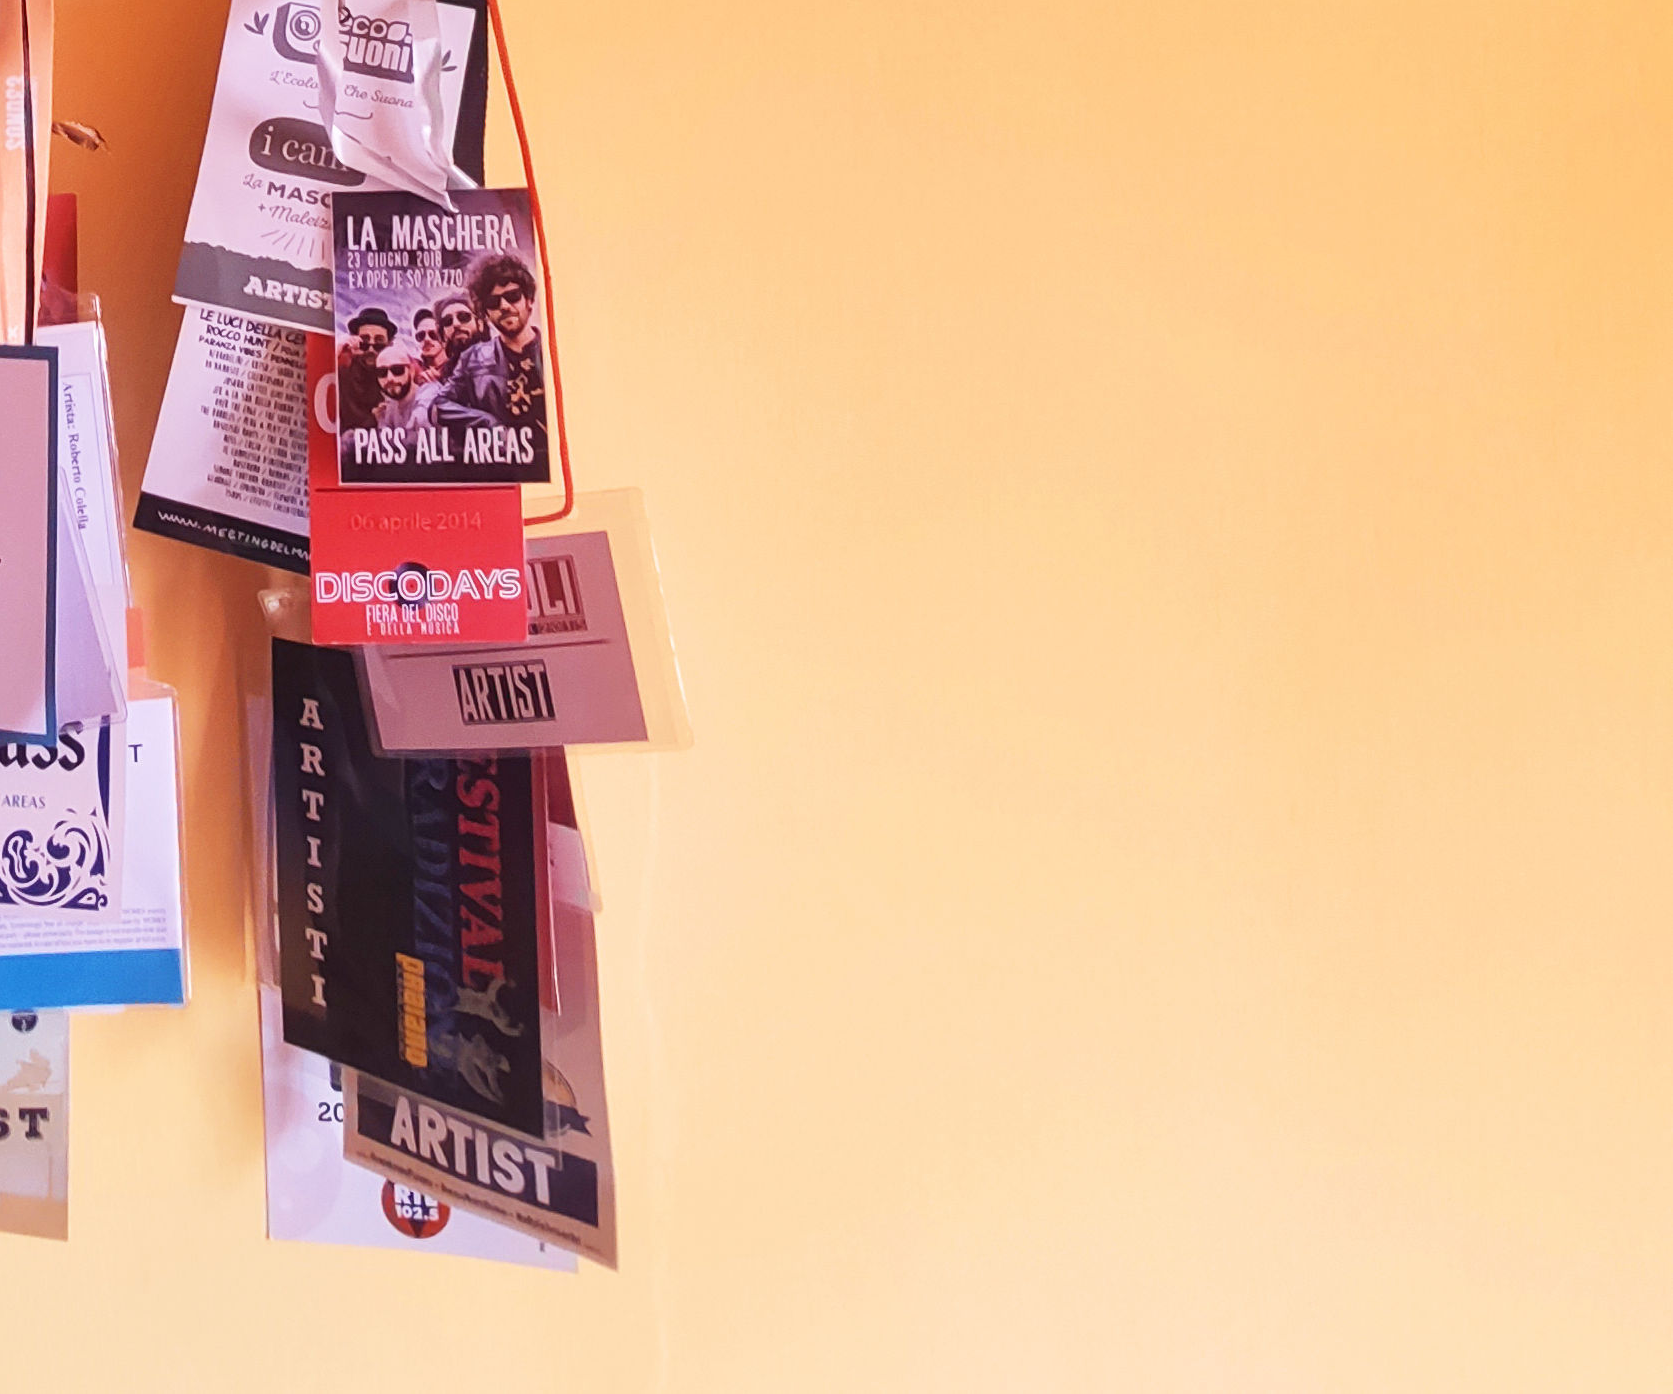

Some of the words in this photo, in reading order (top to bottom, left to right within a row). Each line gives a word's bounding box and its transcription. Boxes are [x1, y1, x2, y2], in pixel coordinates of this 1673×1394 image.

[267, 181, 331, 209] MASC
[347, 215, 377, 251] LA
[391, 214, 519, 255] MASCHERA
[347, 252, 361, 268] 23
[367, 251, 409, 268] GIUGNO
[417, 251, 442, 267] 2018
[349, 270, 364, 288] EX
[367, 269, 389, 288] OPG
[392, 269, 405, 288] JE
[427, 268, 463, 288] PAZZO
[206, 324, 241, 342] ROCCO
[217, 311, 243, 329] LUCI
[245, 317, 282, 340] DELLA
[354, 427, 407, 464] PASS
[415, 426, 455, 464] ALL
[463, 426, 534, 464] AREAS
[350, 513, 375, 531] 06
[378, 512, 432, 534] aprile
[436, 511, 482, 531] 2014
[315, 568, 522, 604] DISCODAYS
[366, 603, 398, 623] FIERA
[401, 603, 421, 622] DEL
[424, 602, 459, 622] DISCO
[459, 664, 551, 721] ARTIST
[0, 794, 46, 809] AREAS
[299, 698, 327, 1007] ARTISTI
[390, 1095, 556, 1206] ARTIST
[394, 1206, 440, 1222] 102.5
